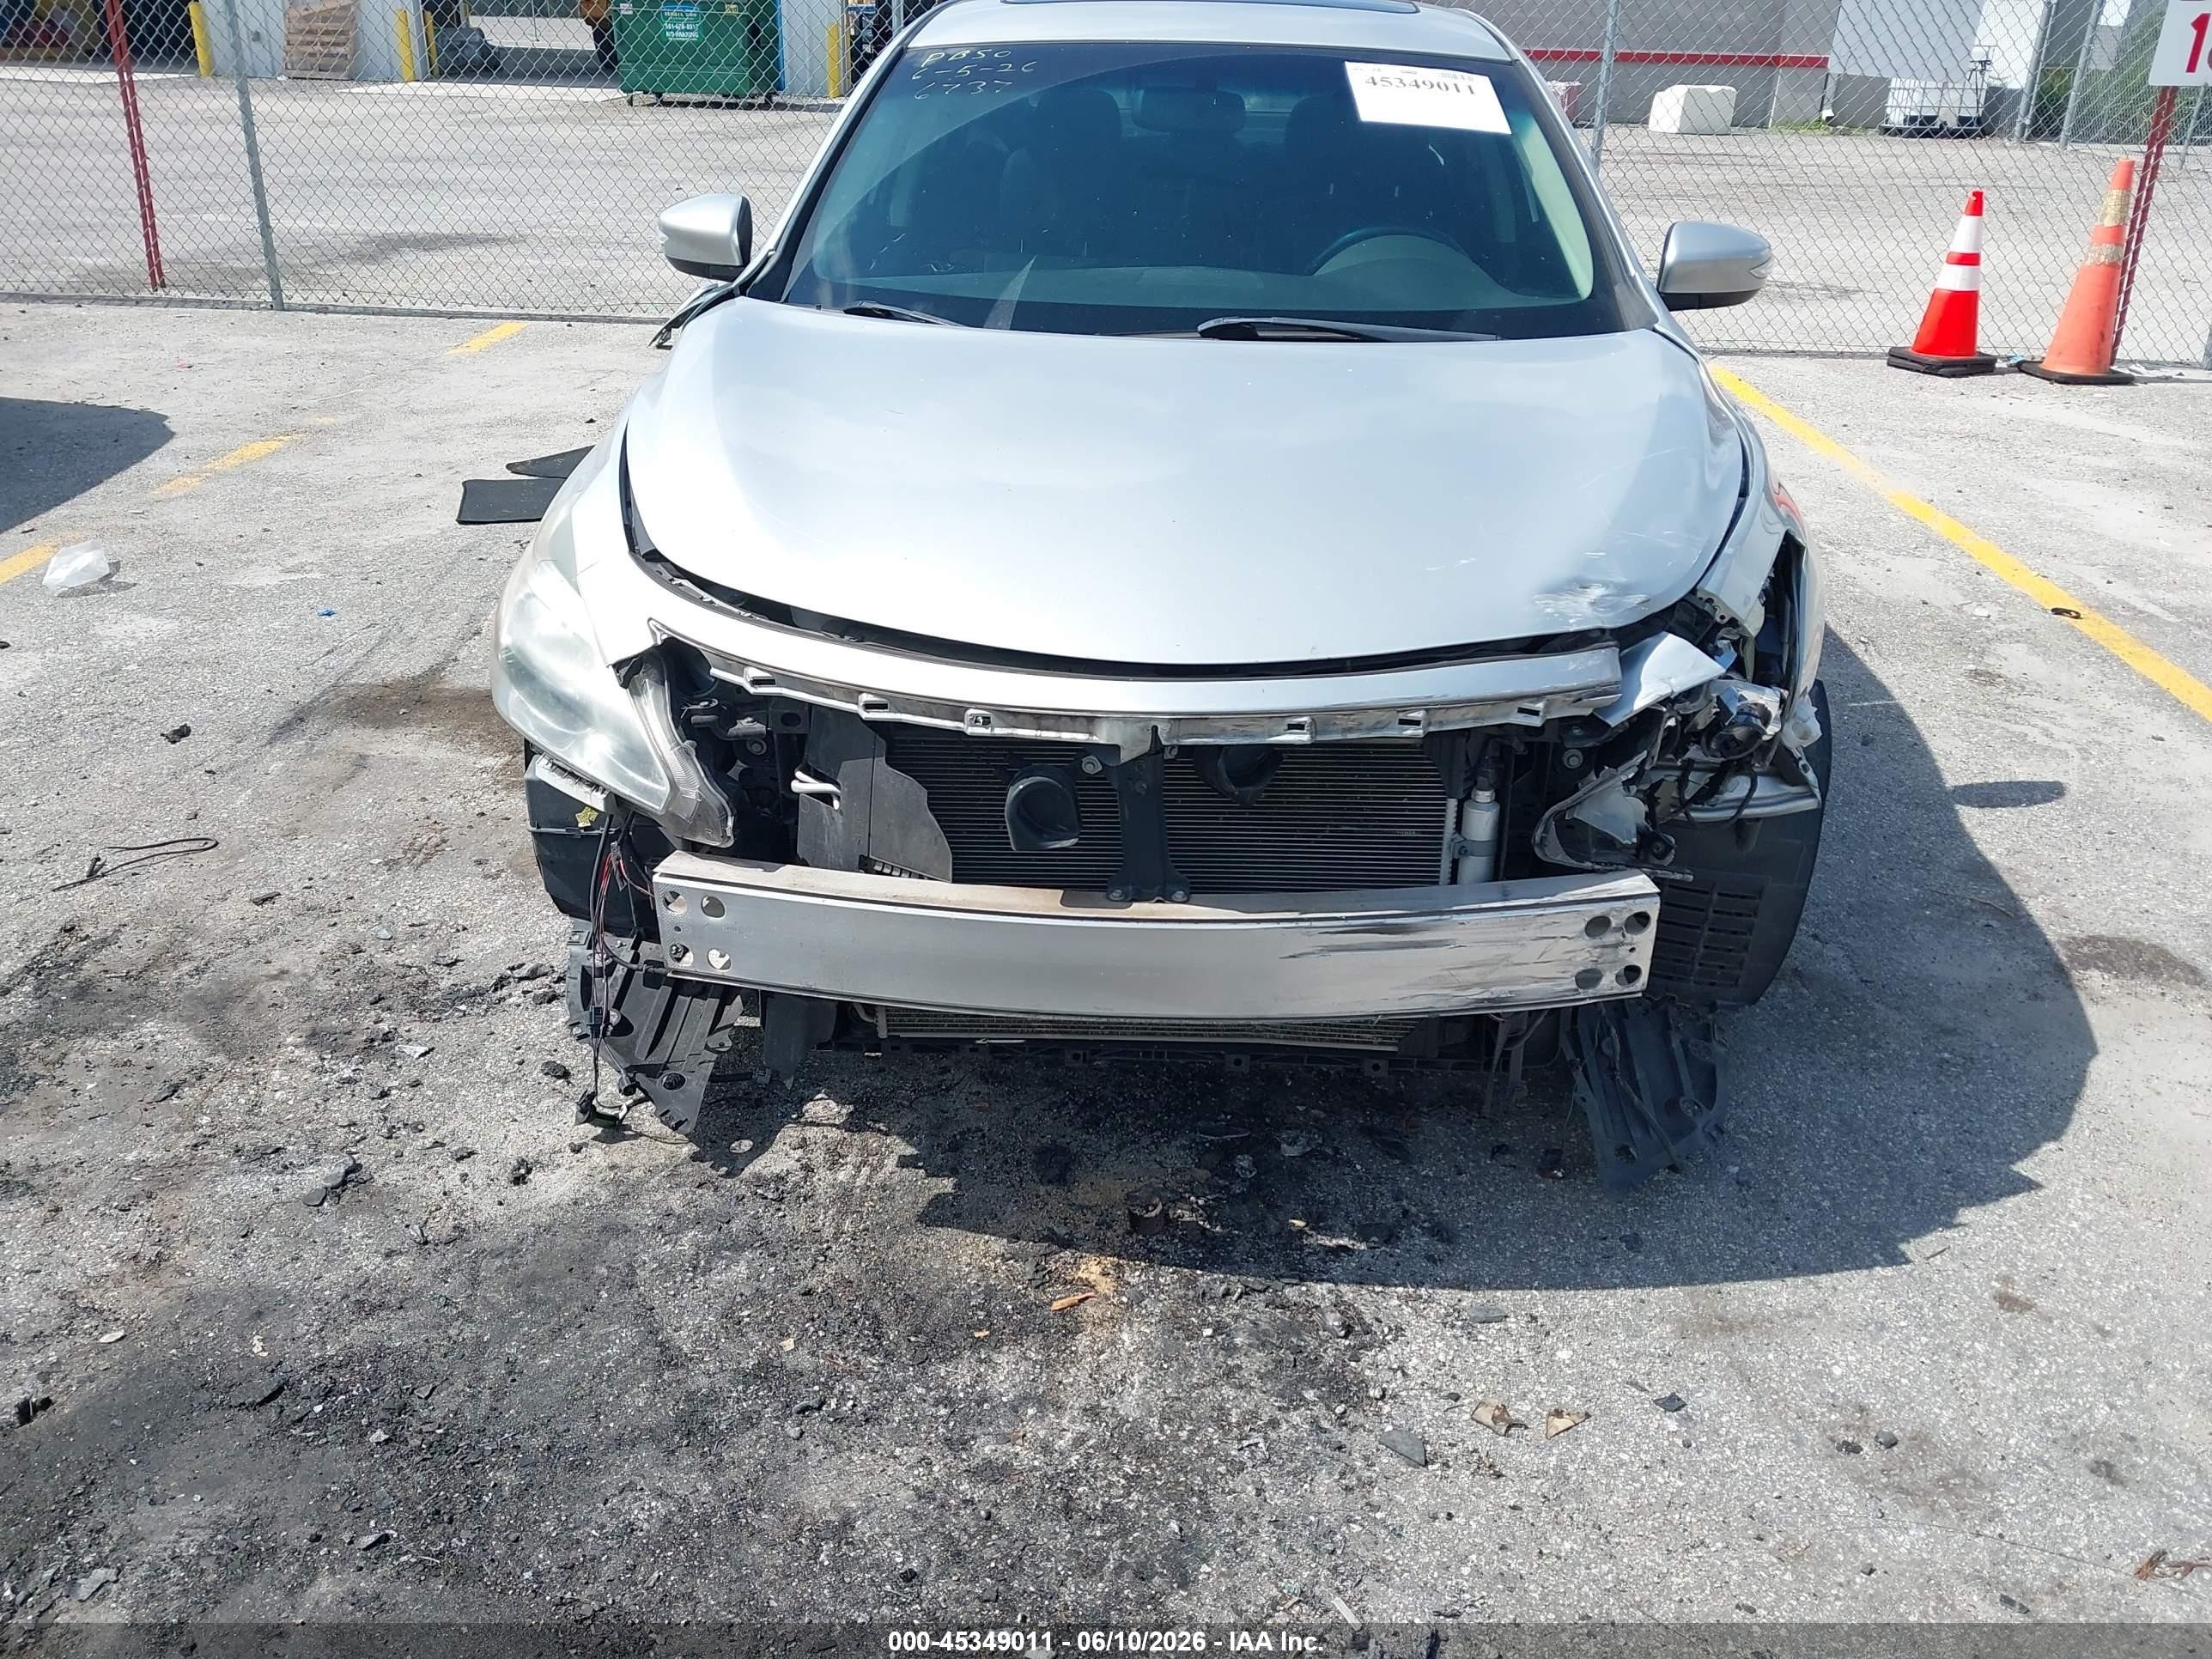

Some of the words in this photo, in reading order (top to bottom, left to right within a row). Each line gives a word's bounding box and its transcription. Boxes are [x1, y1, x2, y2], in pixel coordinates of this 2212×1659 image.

[2185, 12, 2212, 74] 1
[911, 61, 1038, 80] 6-5-26
[914, 80, 1013, 100] 6737
[1365, 76, 1475, 95] 45349011
